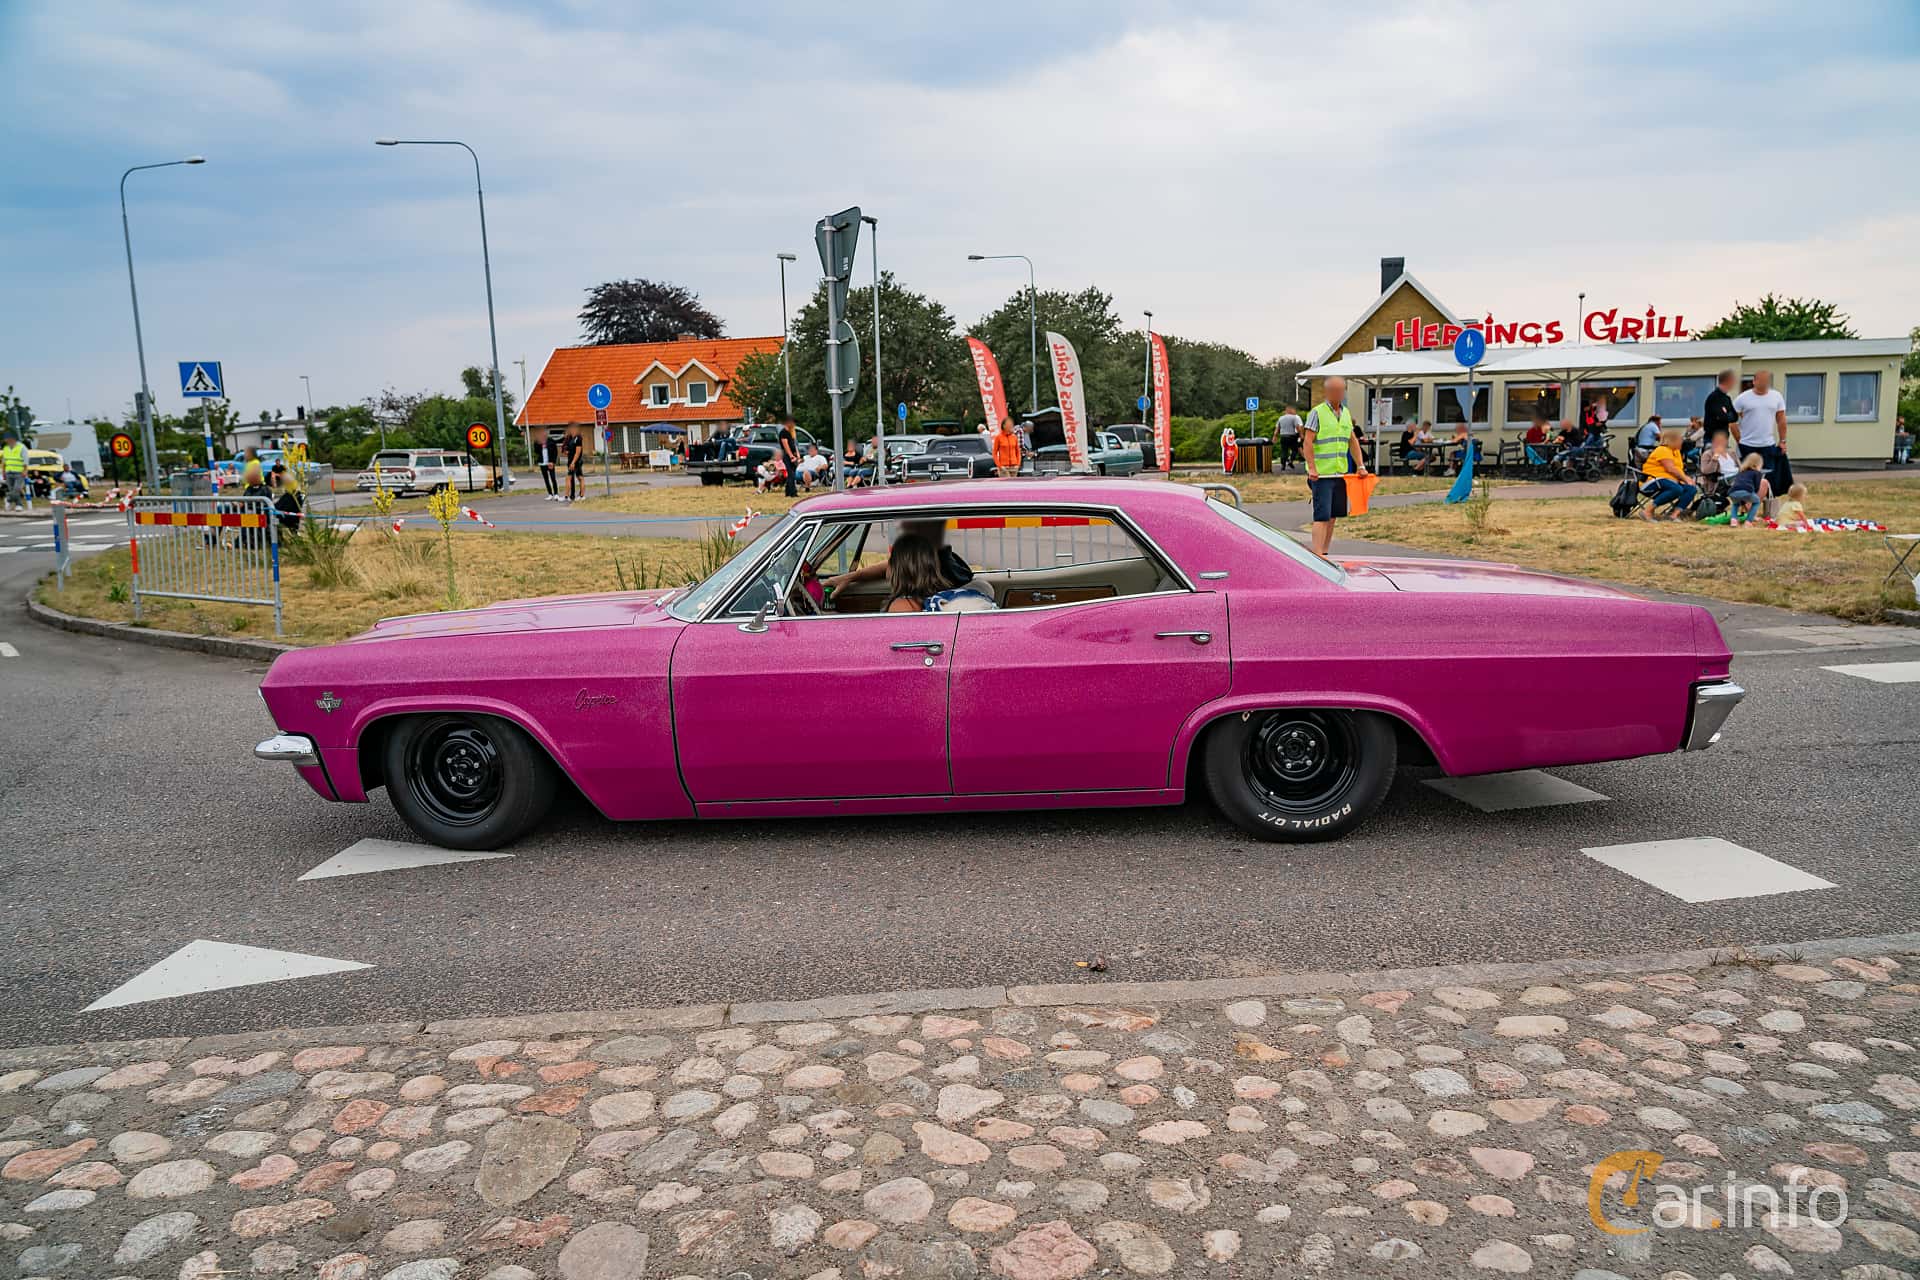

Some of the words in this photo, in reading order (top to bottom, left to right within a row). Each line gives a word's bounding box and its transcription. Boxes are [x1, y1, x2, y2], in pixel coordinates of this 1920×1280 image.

[1583, 304, 1689, 344] GRILL
[115, 440, 129, 451] 30
[472, 431, 486, 442] 30
[1291, 803, 1352, 828] RADIAL
